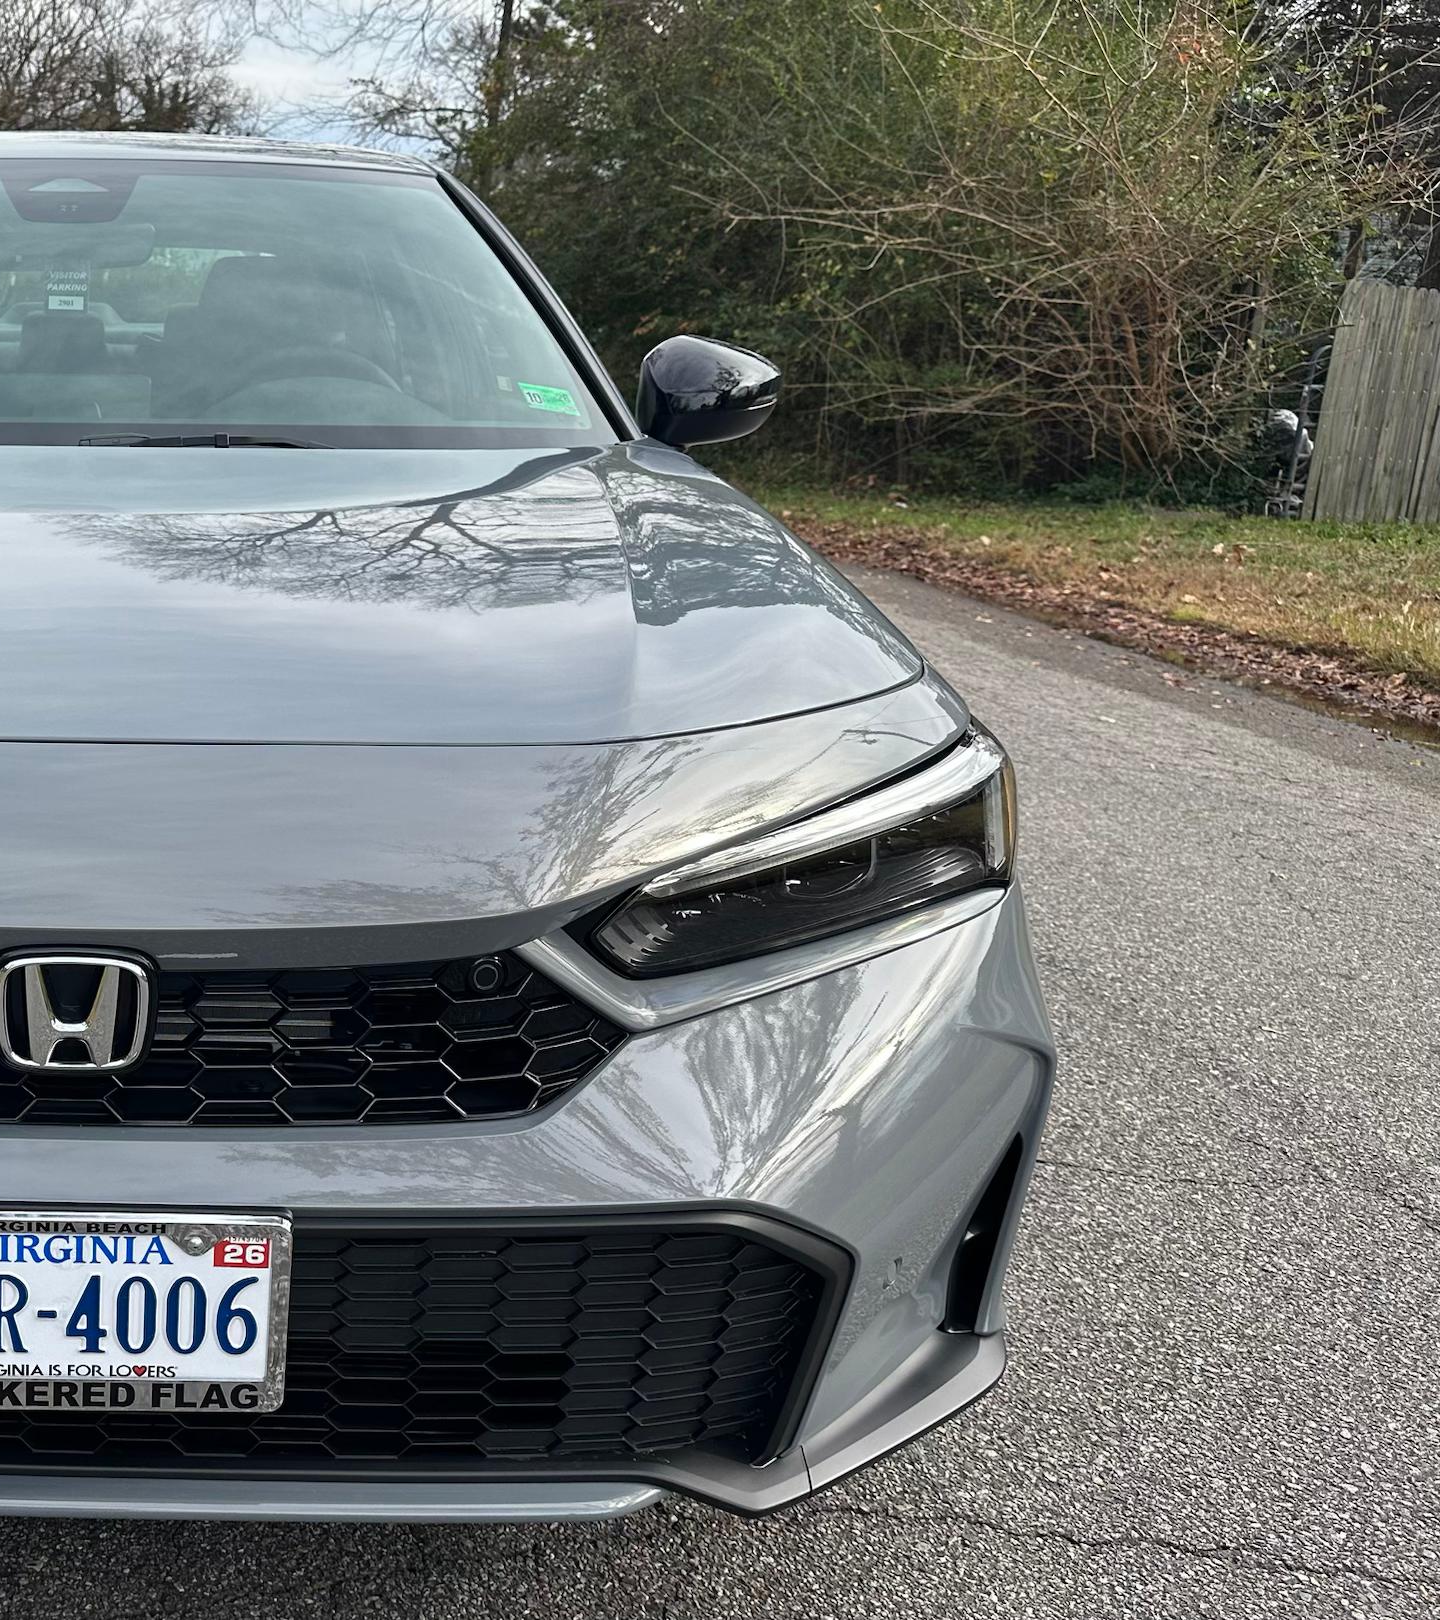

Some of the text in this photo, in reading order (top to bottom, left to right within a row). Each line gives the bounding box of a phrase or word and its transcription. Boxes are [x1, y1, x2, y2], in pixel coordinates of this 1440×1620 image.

[49, 271, 87, 279] VISITOR
[47, 283, 87, 291] PARKING
[526, 391, 544, 404] 10
[87, 1223, 166, 1234] BEACH
[223, 1243, 266, 1264] 26
[48, 1364, 63, 1377] IS
[67, 1365, 104, 1377] FOR
[150, 1381, 260, 1410] FLAG
